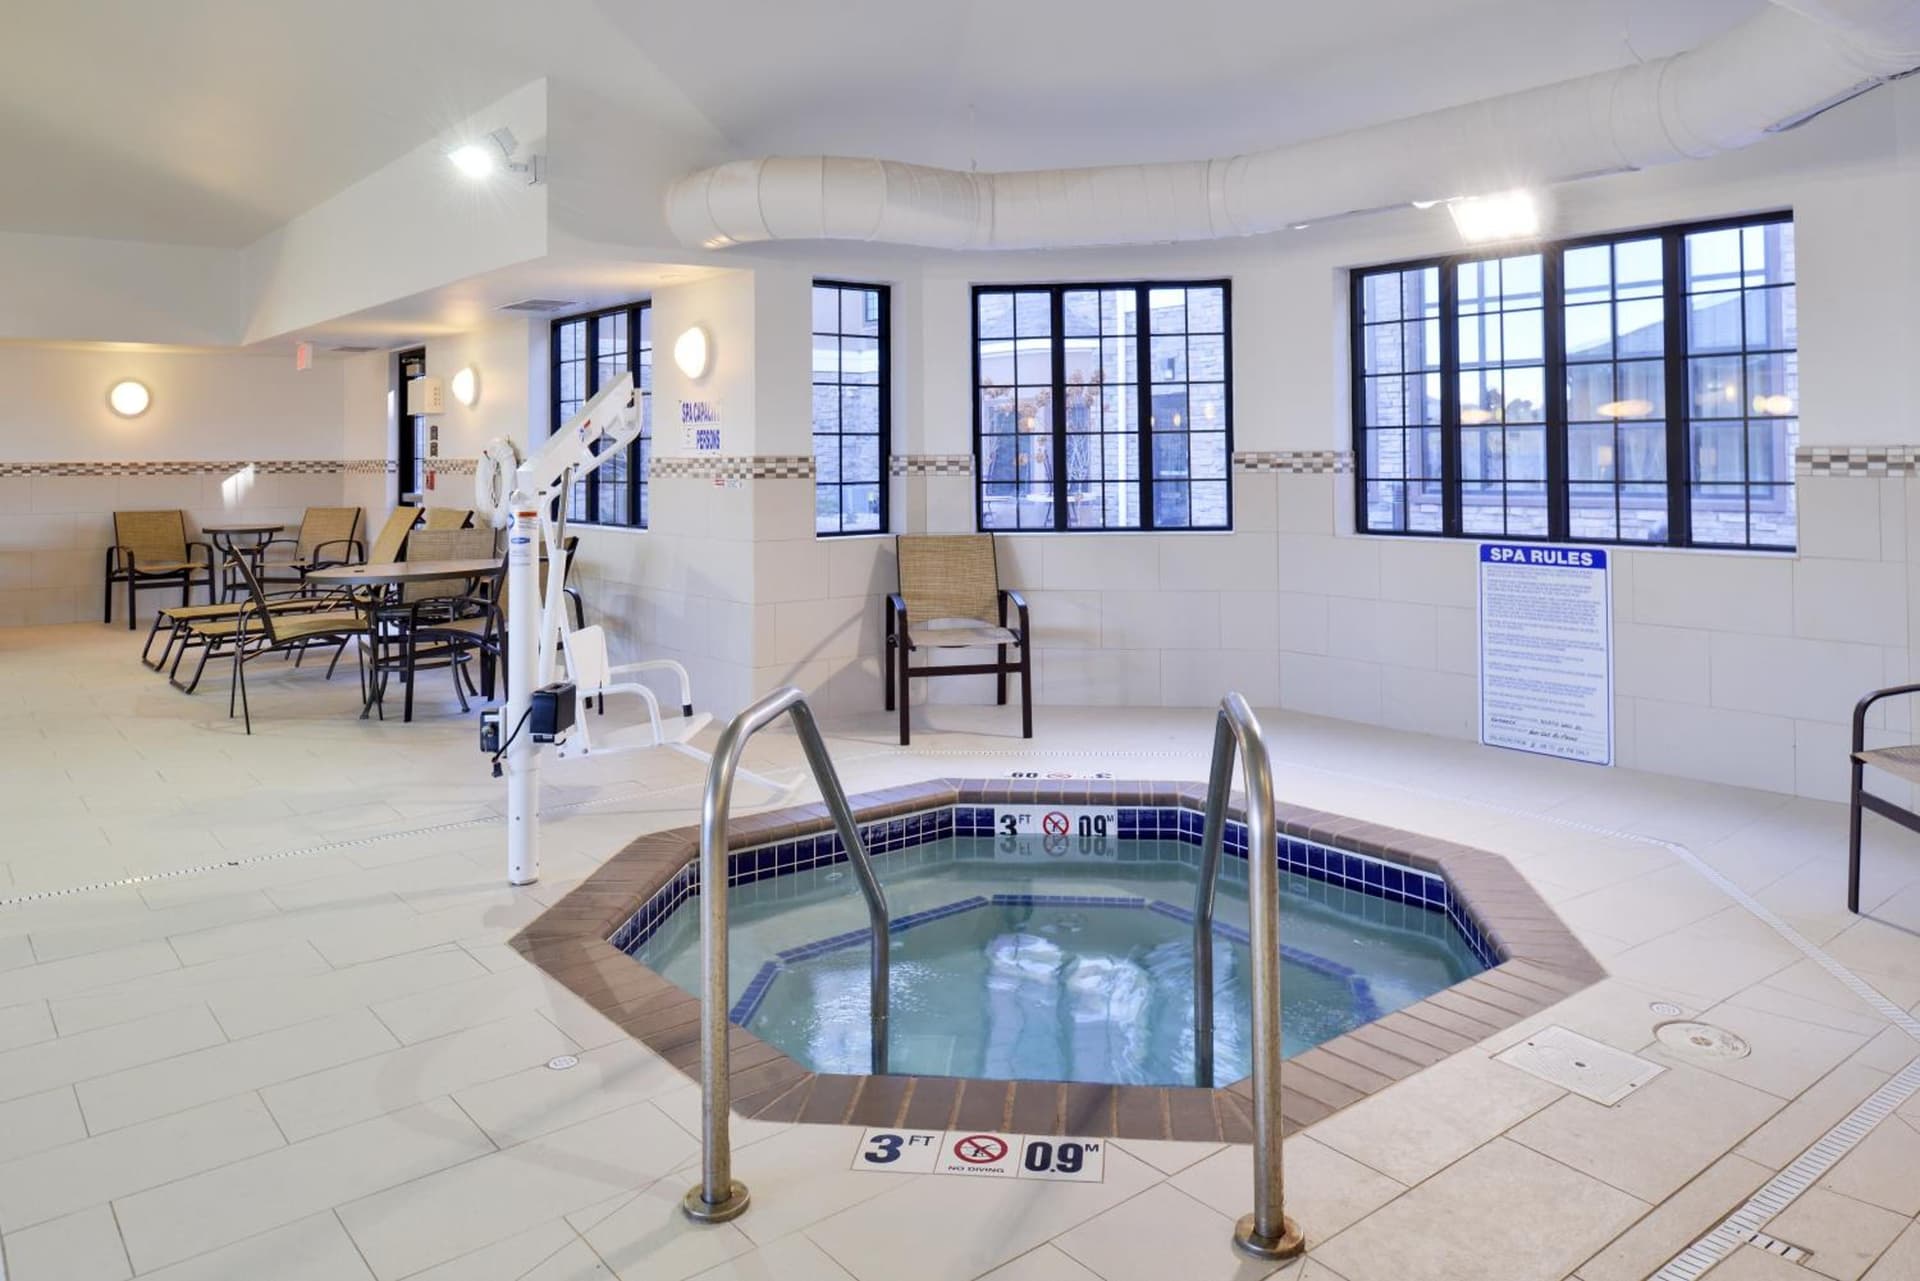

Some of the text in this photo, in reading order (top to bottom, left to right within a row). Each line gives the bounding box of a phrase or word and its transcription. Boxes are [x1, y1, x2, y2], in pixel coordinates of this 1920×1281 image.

[682, 401, 720, 424] SPA CAPA
[1490, 547, 1594, 567] SPA RULES
[1000, 814, 1018, 836] 3
[864, 1134, 935, 1164] 3 FT
[1024, 1141, 1084, 1173] 0.9
[967, 1166, 1005, 1174] DIVING
